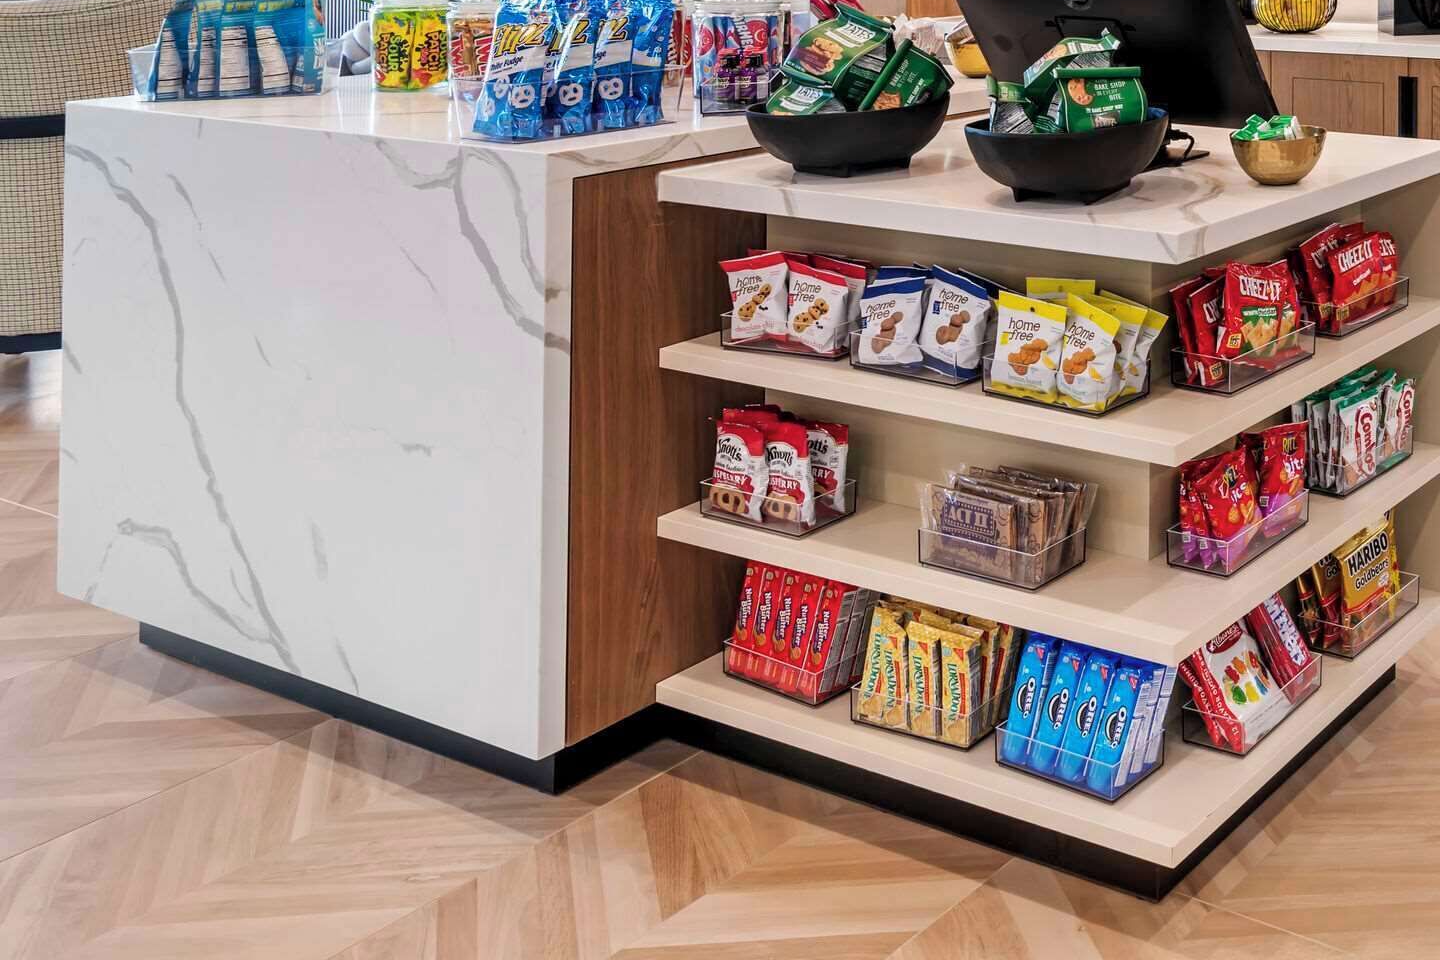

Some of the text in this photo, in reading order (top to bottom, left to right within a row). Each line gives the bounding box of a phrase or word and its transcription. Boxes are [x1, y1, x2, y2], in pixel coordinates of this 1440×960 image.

[378, 32, 390, 73] PATCH
[388, 34, 400, 71] SOUR
[429, 31, 440, 72] PATCH
[503, 55, 524, 67] Fudge
[1094, 81, 1126, 91] BAKE SHOP
[735, 275, 763, 289] home
[737, 283, 760, 296] free
[793, 280, 821, 294] home
[1239, 275, 1282, 302] CHEEZ-IT
[794, 291, 815, 303] free
[865, 299, 896, 314] home
[939, 288, 969, 305] home
[940, 299, 960, 313] free
[867, 309, 890, 323] free
[1008, 317, 1041, 332] home
[1009, 330, 1034, 341] free
[1068, 321, 1096, 341] home
[1066, 335, 1087, 350] free
[718, 437, 743, 462] Knott's
[949, 505, 972, 524] ACT
[1347, 531, 1389, 577] HARIBO
[1355, 558, 1390, 590] Goldbears
[745, 587, 753, 615] Nutter
[764, 592, 772, 620] Nutter
[800, 605, 808, 634] Nutter
[823, 610, 831, 640] Nutter
[817, 622, 825, 650] Butter
[1022, 677, 1036, 719] OREO
[1053, 688, 1069, 730] OREO
[1081, 696, 1097, 738] OREO
[1111, 706, 1127, 749] OREO
[1231, 725, 1240, 736] 12
